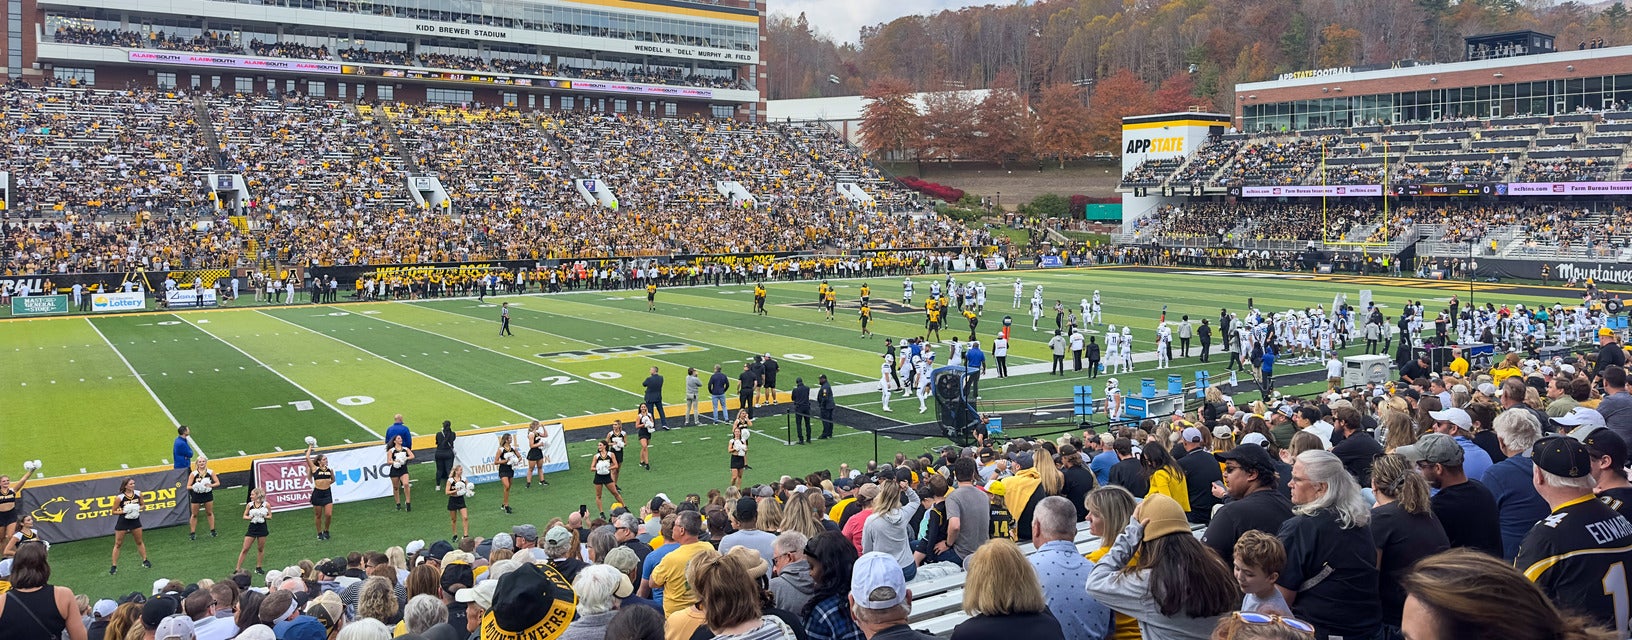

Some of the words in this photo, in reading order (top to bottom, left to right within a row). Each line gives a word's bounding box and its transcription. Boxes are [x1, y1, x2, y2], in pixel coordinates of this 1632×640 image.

[415, 24, 435, 32] KIDD
[438, 26, 470, 35] BREWER
[474, 29, 506, 38] STADIUM
[634, 45, 664, 53] WENDELL
[189, 56, 236, 64] ALARMSOUTH
[296, 63, 339, 71] ALARMSOUTH
[109, 299, 143, 308] Lottery
[281, 466, 308, 479] FAR
[265, 477, 314, 493] BUREA
[74, 487, 176, 511] YUON
[993, 520, 1009, 537] 14
